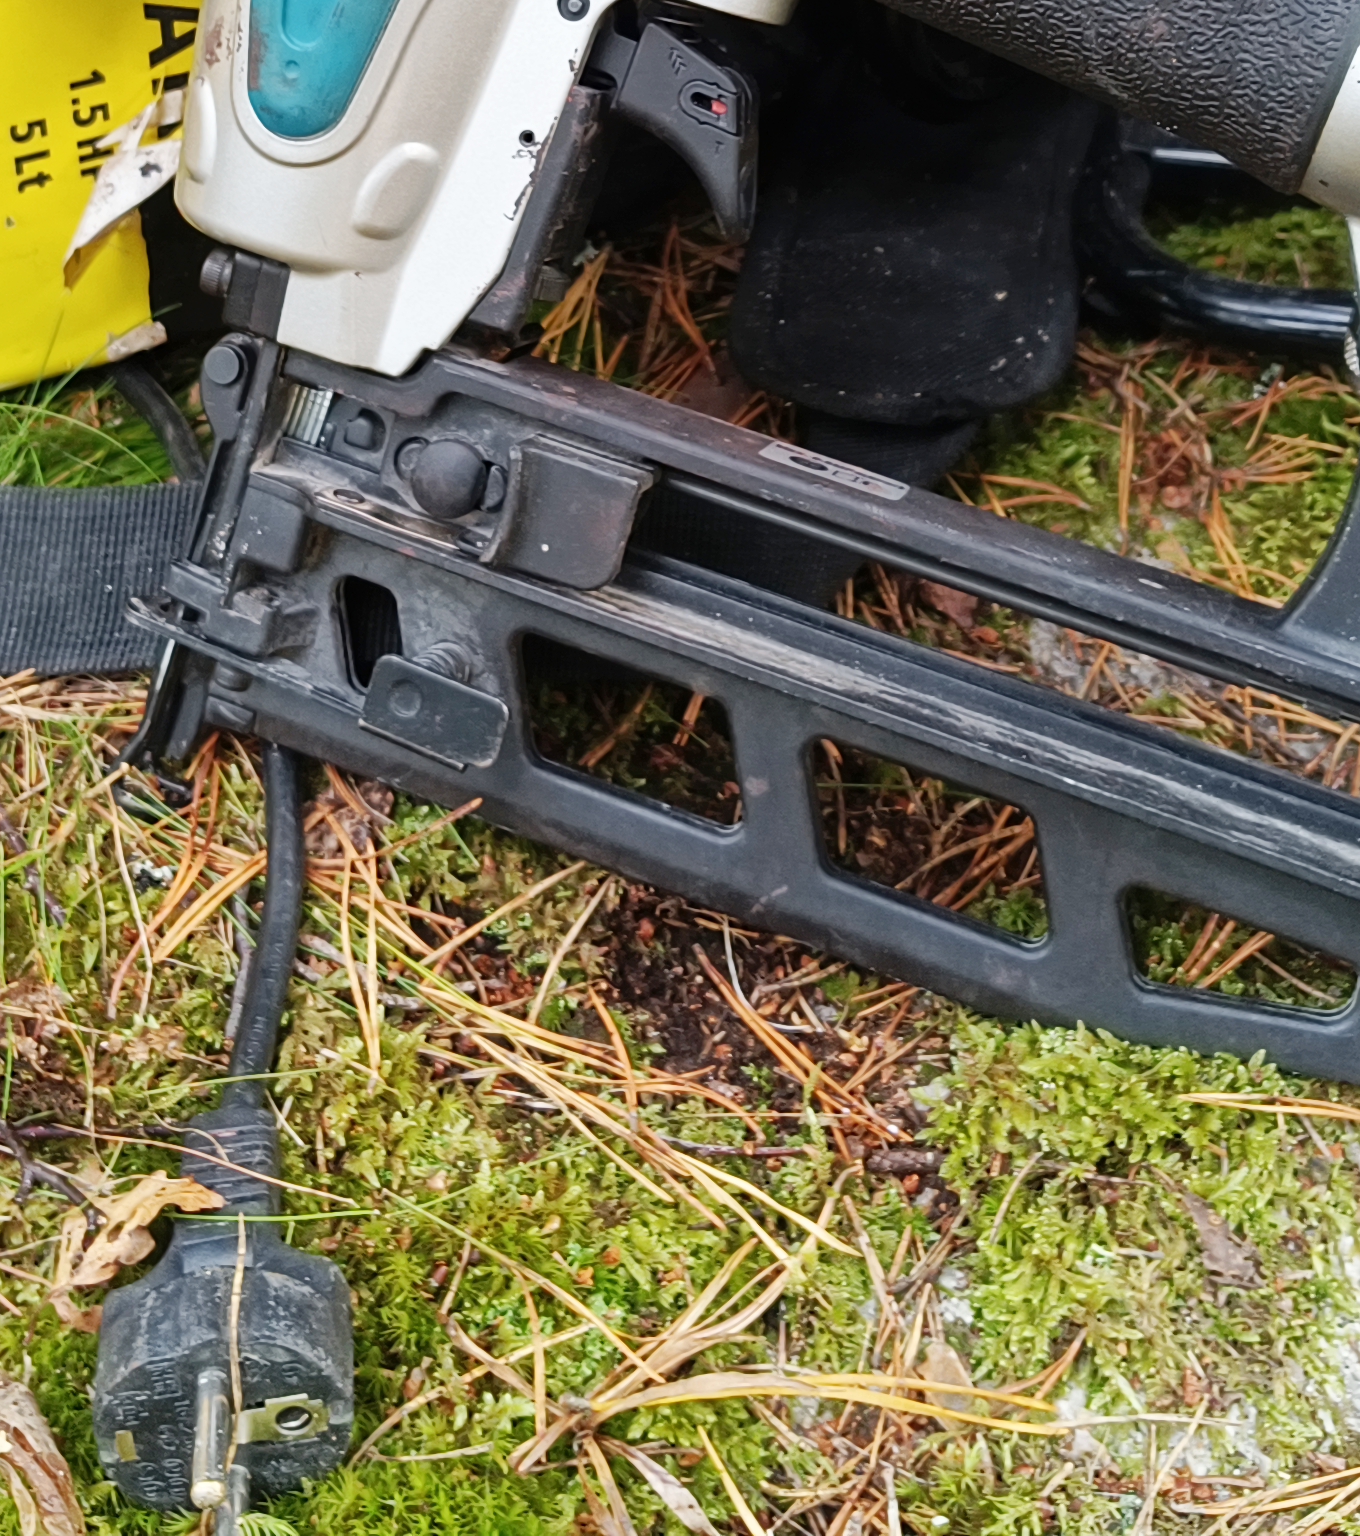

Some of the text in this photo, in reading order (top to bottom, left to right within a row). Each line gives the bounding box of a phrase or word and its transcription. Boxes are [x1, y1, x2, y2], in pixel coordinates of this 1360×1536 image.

[69, 68, 112, 129] 1.5
[9, 118, 53, 194] 5 Lt
